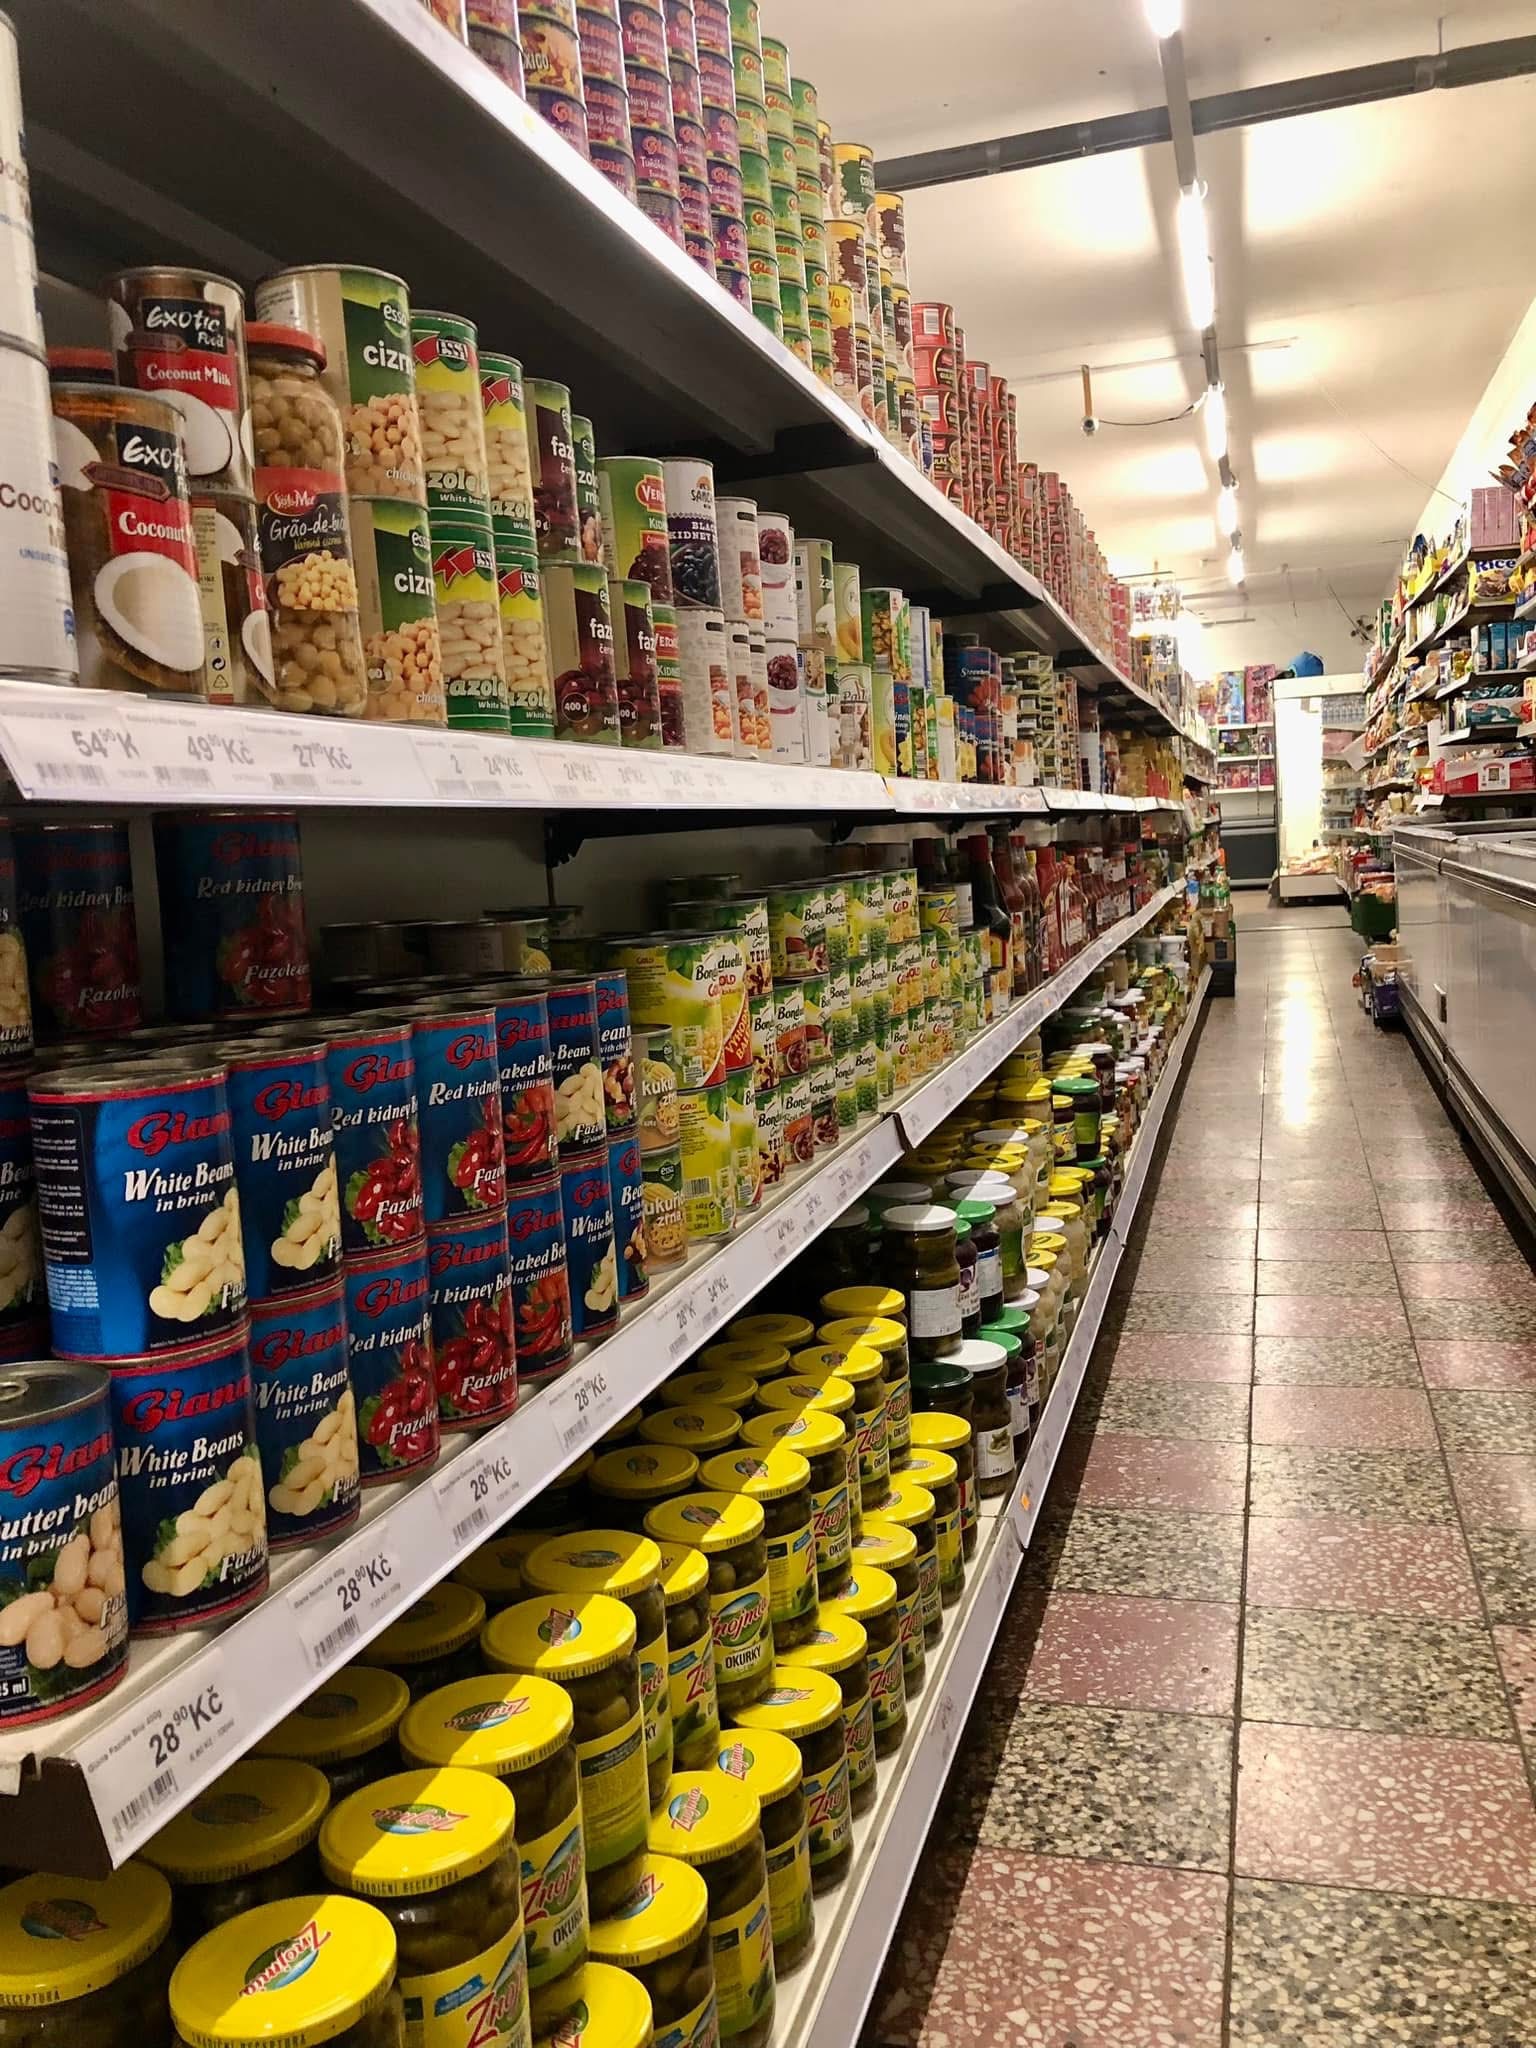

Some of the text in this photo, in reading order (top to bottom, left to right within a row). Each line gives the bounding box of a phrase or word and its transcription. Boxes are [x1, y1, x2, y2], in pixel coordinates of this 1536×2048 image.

[147, 305, 220, 332] Exotic
[147, 364, 232, 386] Coconut Milk
[440, 494, 467, 504] White
[119, 511, 186, 542] Coconut
[1475, 559, 1517, 573] Rice
[478, 701, 499, 710] White
[526, 711, 545, 720] White
[564, 702, 581, 712] 400
[56, 889, 112, 909] kidney
[198, 877, 230, 898] Red
[236, 877, 286, 895] kidney
[557, 1045, 591, 1061] Beans
[429, 1082, 462, 1106] Red
[331, 1106, 363, 1131] Red
[251, 1131, 307, 1162] White
[278, 1152, 325, 1172] in brine
[124, 1162, 234, 1202] White Beans
[156, 1190, 216, 1213] in brine
[572, 1216, 603, 1238] White
[656, 1211, 682, 1227] zrna
[513, 1274, 524, 1285] in
[443, 1281, 494, 1304] kidney
[380, 1323, 422, 1348] kidney
[256, 1368, 349, 1409] White Beans
[591, 1372, 607, 1398] Kč
[276, 1397, 329, 1420] in brine
[121, 1430, 244, 1477] White Beans
[150, 1464, 215, 1489] in brine
[491, 1456, 512, 1484] Kč
[0, 1500, 69, 1540] utter
[2, 1526, 80, 1562] in brine
[366, 1552, 392, 1588] Kč
[725, 1645, 762, 1669] OKURKY
[12, 1677, 27, 1693] ml
[189, 1685, 224, 1731] Kč
